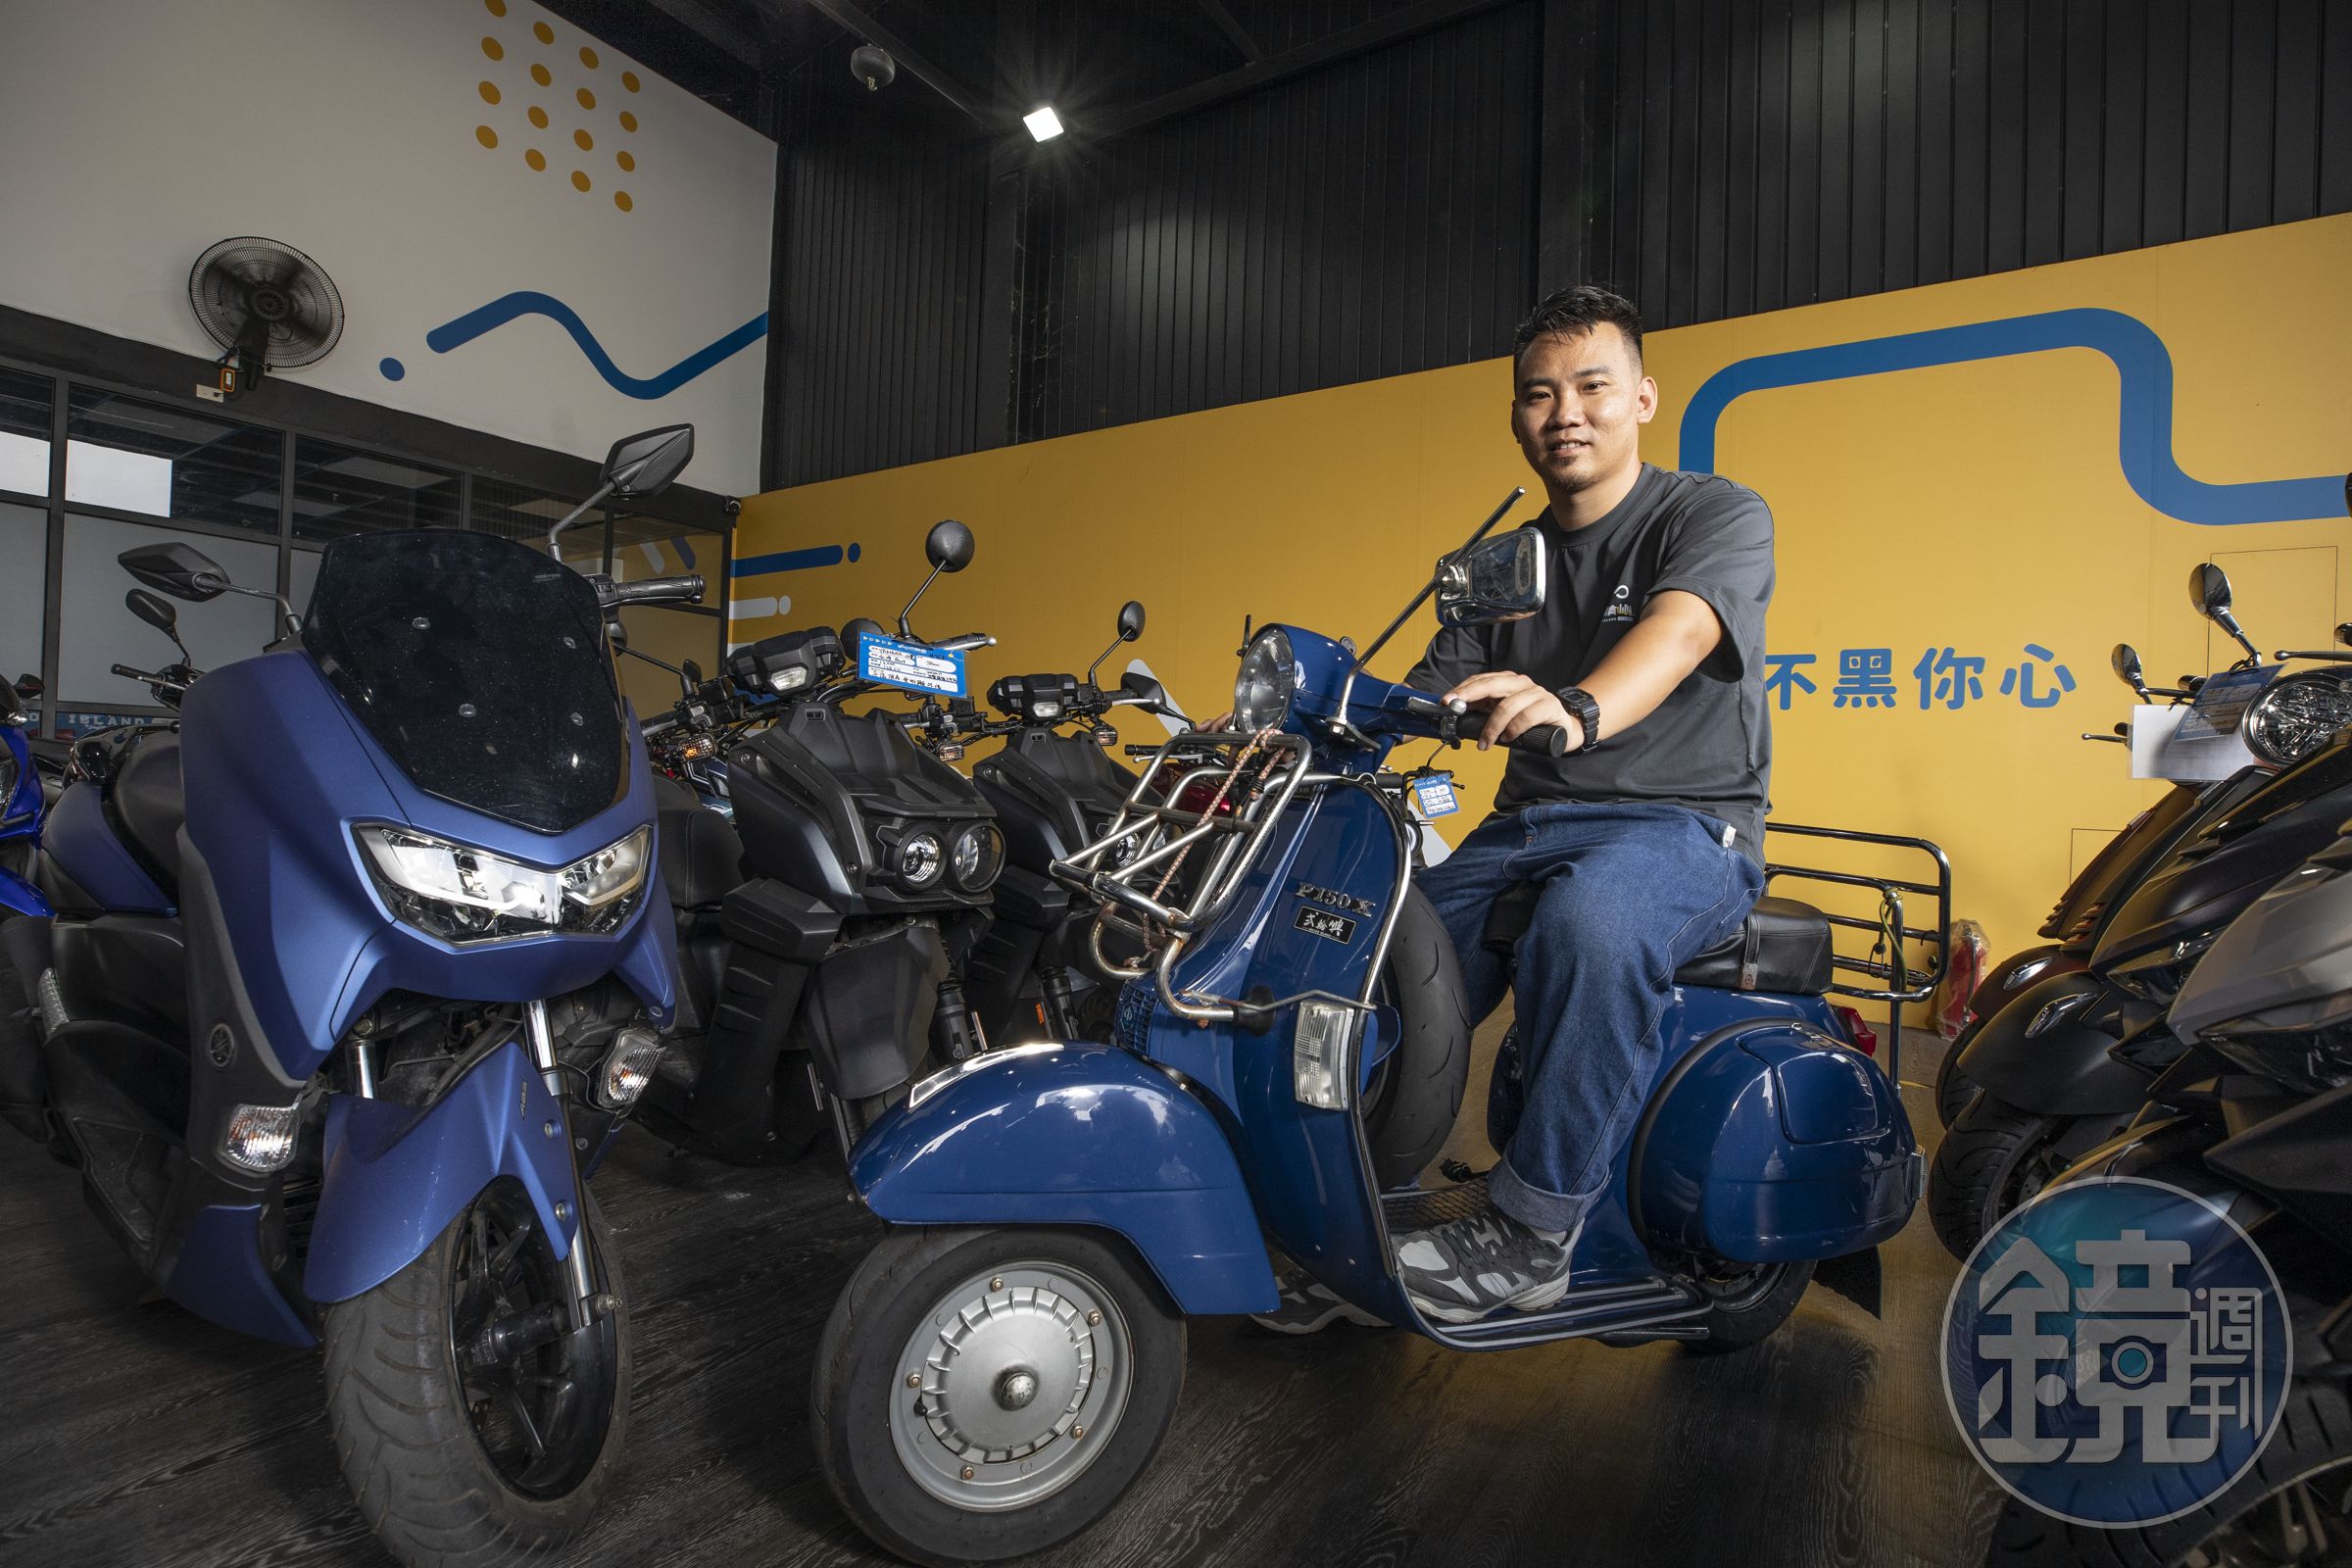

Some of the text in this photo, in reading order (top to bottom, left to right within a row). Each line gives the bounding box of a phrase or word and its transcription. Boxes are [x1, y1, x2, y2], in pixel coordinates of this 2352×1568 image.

[1765, 643, 2077, 710] 不黑你心
[69, 713, 145, 725] ISLAND
